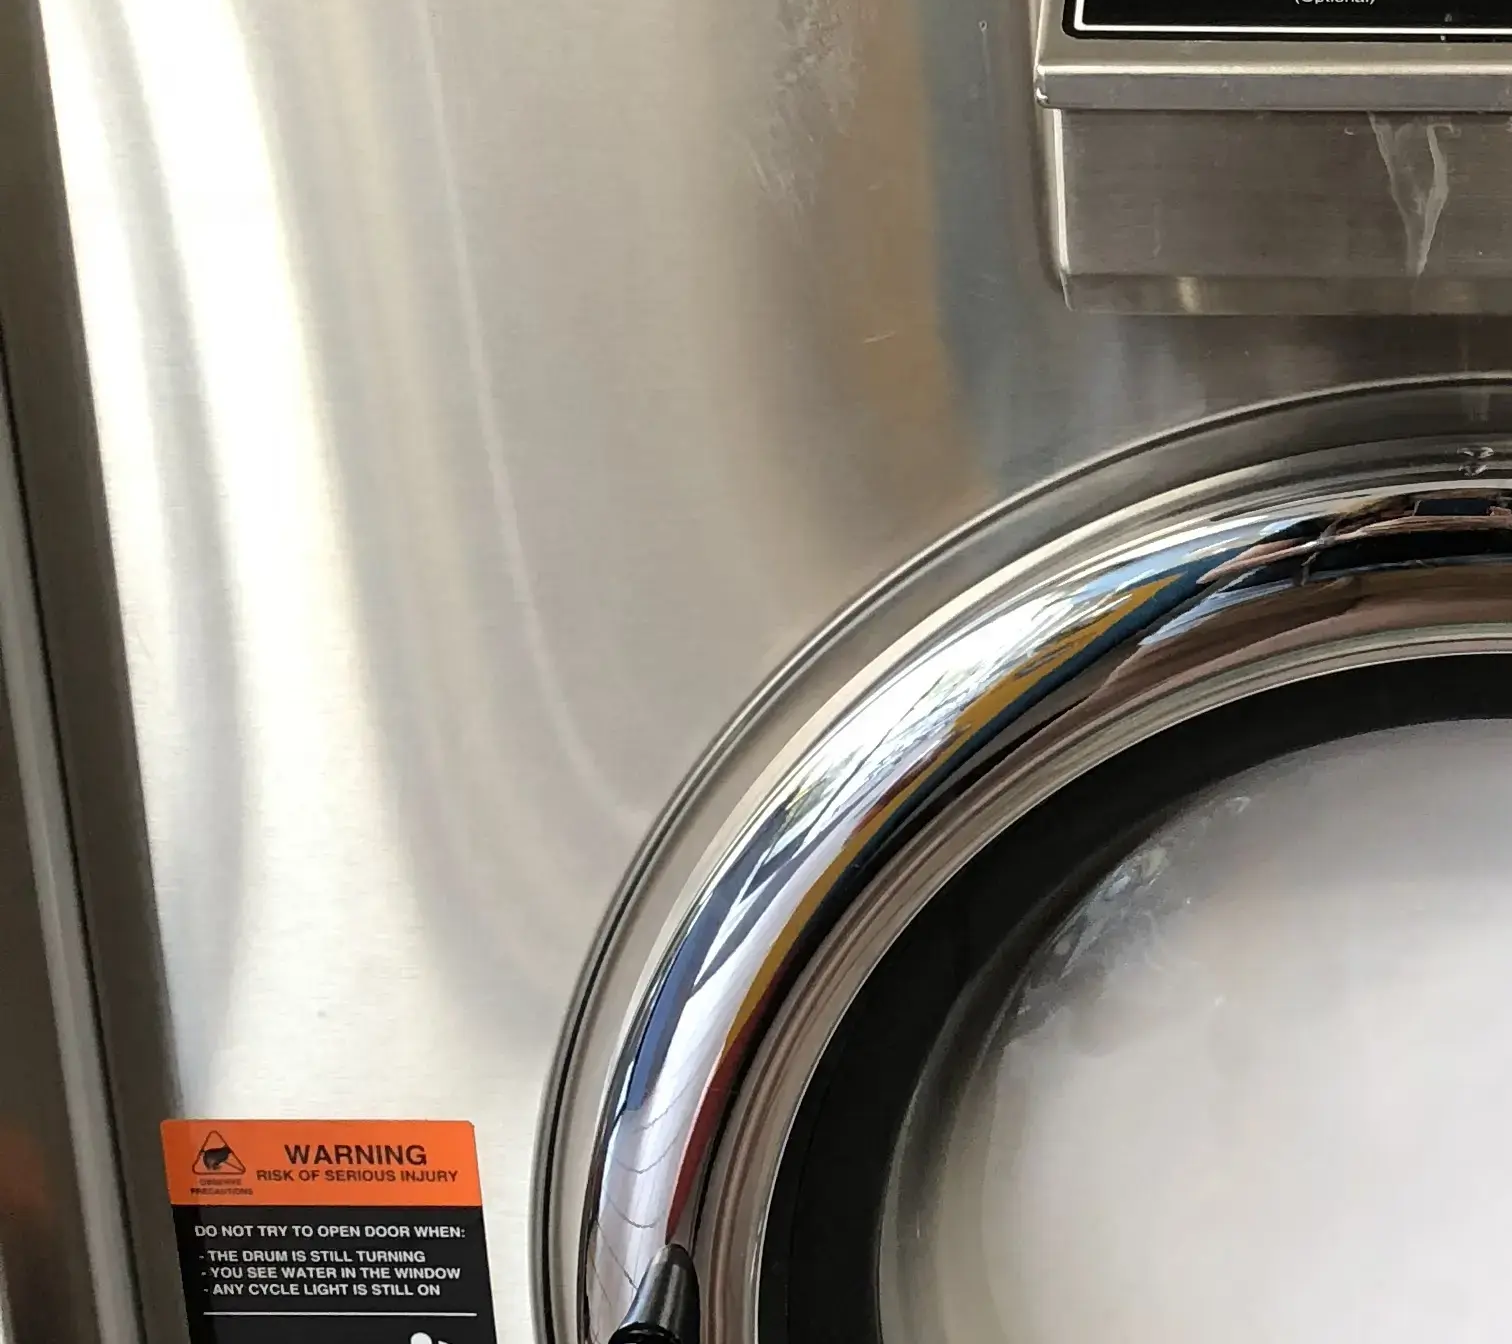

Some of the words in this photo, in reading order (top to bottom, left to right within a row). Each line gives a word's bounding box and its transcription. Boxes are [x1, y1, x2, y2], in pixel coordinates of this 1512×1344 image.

[285, 1145, 427, 1165] WARNING
[257, 1170, 294, 1181] RISK
[299, 1170, 320, 1181] OF
[325, 1170, 396, 1182] SERIOUS
[400, 1170, 458, 1182] INJURY
[195, 1226, 217, 1237] DO
[222, 1226, 252, 1237] NOT
[258, 1226, 288, 1237] TRY
[292, 1226, 313, 1237] TO
[318, 1226, 361, 1237] OPEN
[365, 1226, 410, 1238] DOOR
[414, 1226, 465, 1238] WHEN:
[208, 1251, 238, 1262] THE
[243, 1251, 288, 1262] DRUM
[292, 1251, 306, 1262] IS
[310, 1251, 352, 1262] STILL
[356, 1251, 426, 1262] TURNING
[209, 1267, 243, 1278] YOU
[248, 1268, 277, 1278] SEE
[282, 1268, 337, 1278] WATER
[341, 1268, 356, 1278] IN
[361, 1268, 391, 1278] THE
[395, 1268, 461, 1279] WINDOW
[213, 1284, 243, 1295] ANY
[249, 1284, 299, 1295] CYCLE
[304, 1284, 348, 1295] LIGHT
[353, 1284, 367, 1295] IS
[371, 1284, 413, 1295] STILL
[418, 1284, 440, 1295] ON
